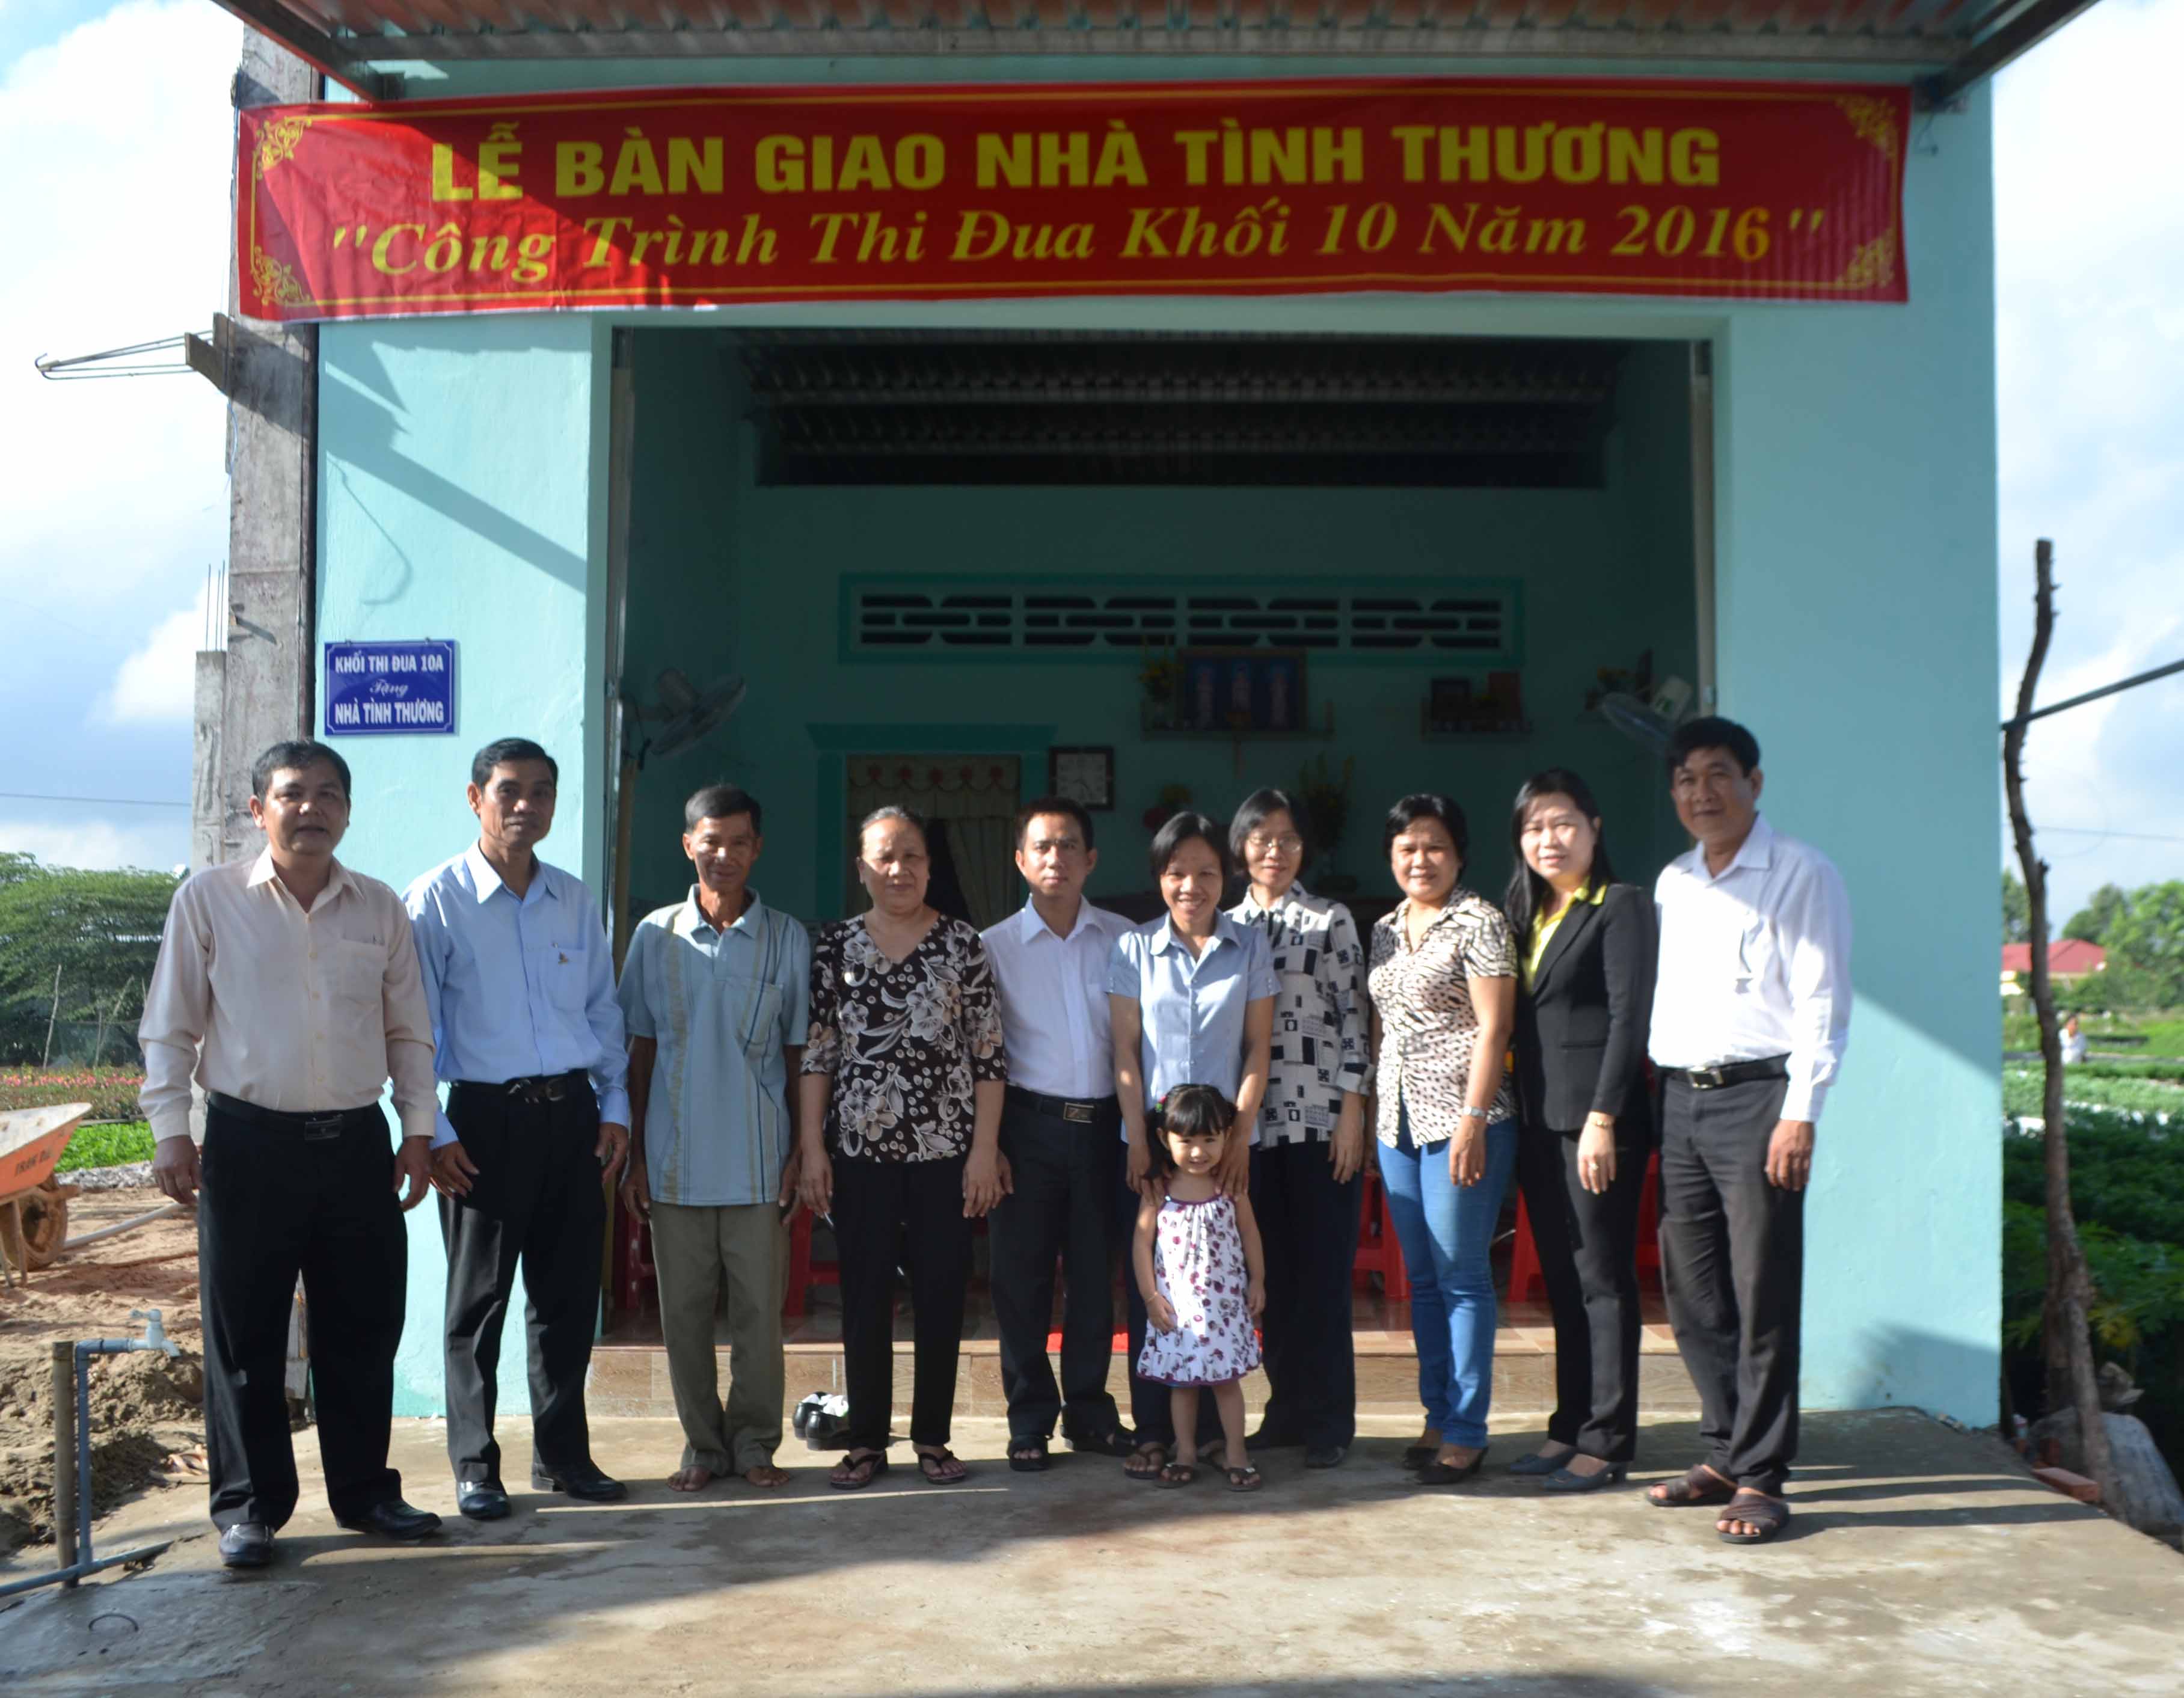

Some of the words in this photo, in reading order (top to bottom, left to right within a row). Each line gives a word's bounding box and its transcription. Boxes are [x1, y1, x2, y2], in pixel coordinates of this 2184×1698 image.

[431, 121, 524, 202] LỄ
[554, 125, 725, 197] BÀN
[755, 131, 946, 194] GIAO
[975, 118, 1150, 189] NHÀ
[1173, 116, 1365, 188] TÌNH
[1390, 119, 1722, 188] THƯƠNG
[583, 212, 778, 268] Trình
[808, 210, 928, 264] Thi
[948, 210, 1096, 261] Đua
[1118, 194, 1291, 259] Khối
[1317, 202, 1398, 256] 10
[1419, 201, 1586, 256] Năm
[335, 650, 365, 673] KHỐI
[368, 654, 388, 673] THI
[391, 654, 417, 672] ĐUA
[421, 654, 444, 672] 10A
[335, 697, 360, 725] NHÀ
[363, 697, 391, 724] TÌNH
[394, 697, 444, 723] THƯƠNG
